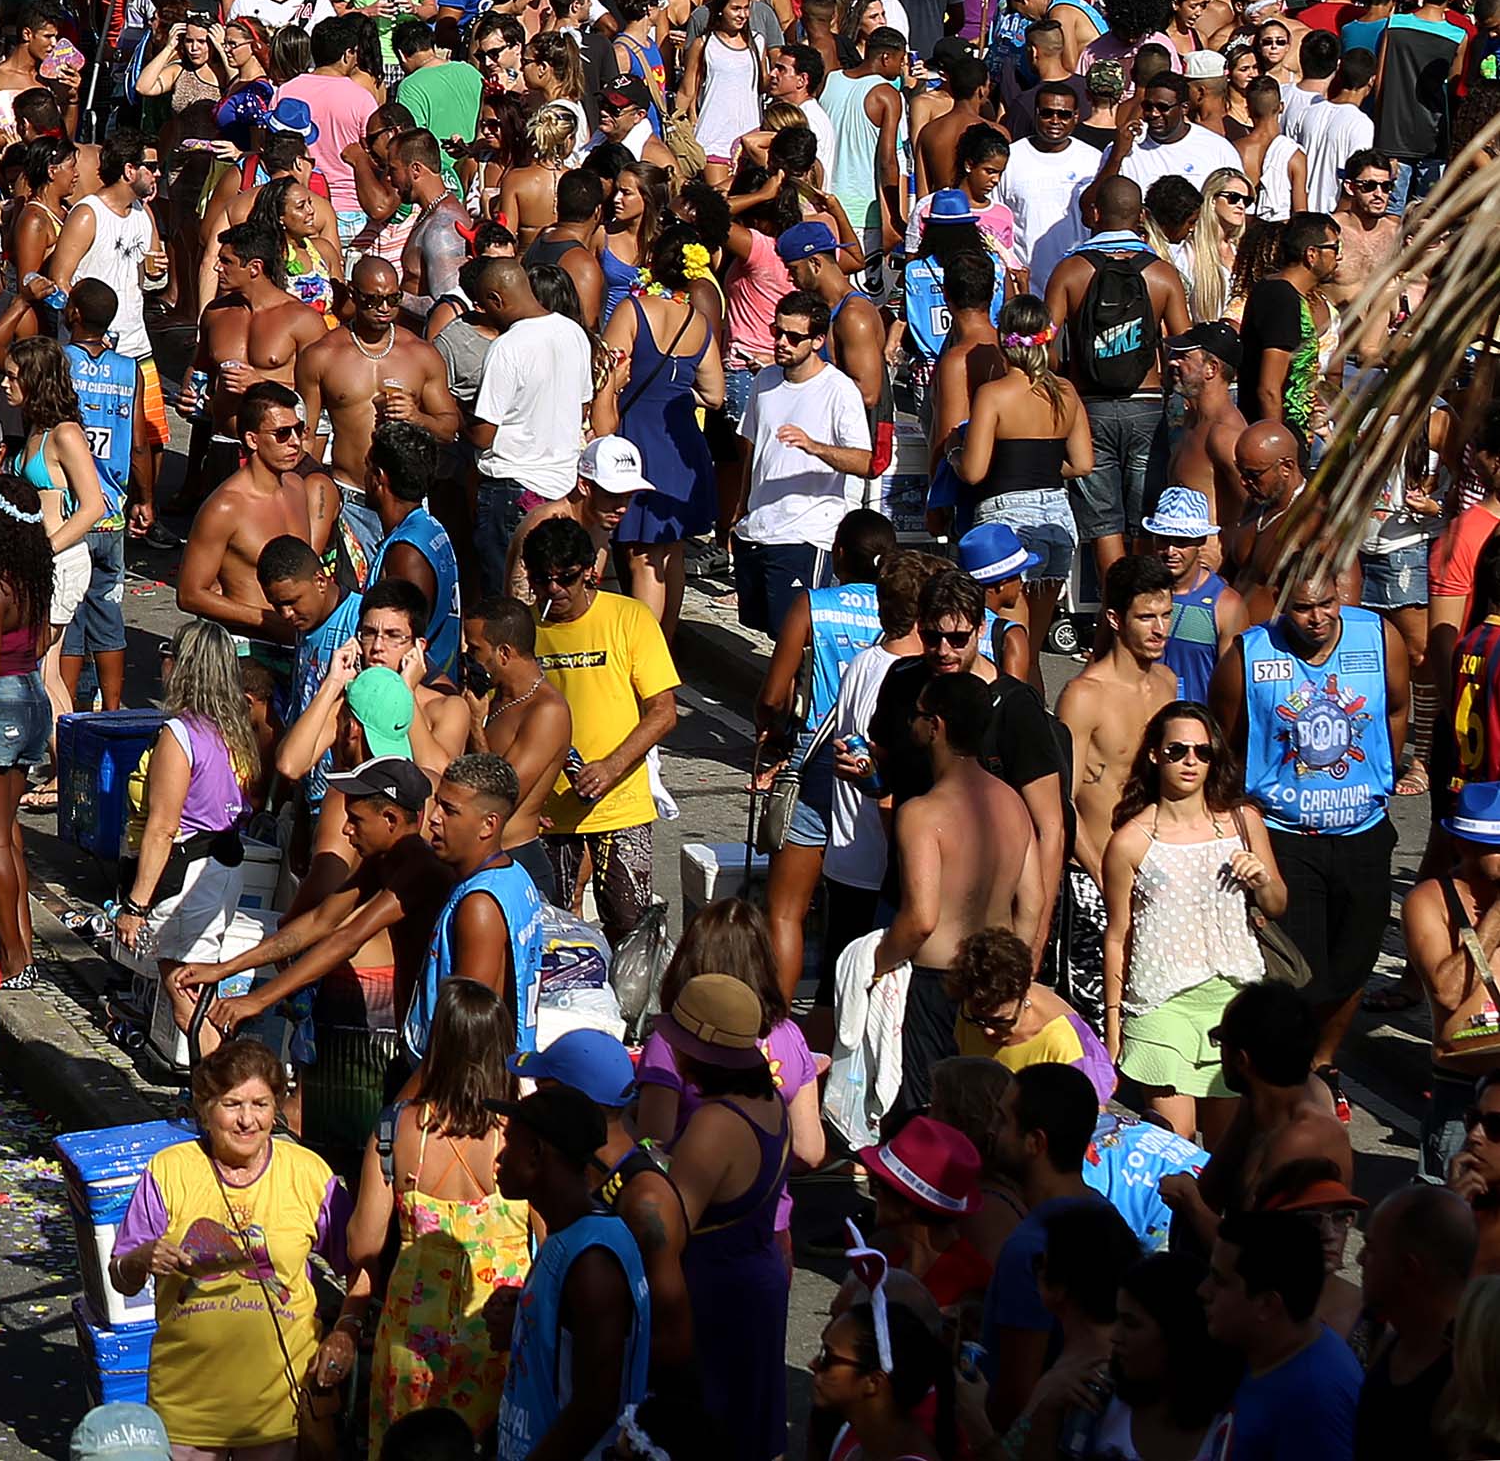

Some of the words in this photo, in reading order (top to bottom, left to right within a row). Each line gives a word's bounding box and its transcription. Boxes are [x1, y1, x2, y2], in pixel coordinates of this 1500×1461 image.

[1094, 317, 1143, 358] NIKE
[78, 360, 113, 377] 2015
[1297, 717, 1348, 750] BOA
[1299, 783, 1371, 812] CARNAVAL
[1321, 808, 1356, 828] RUA
